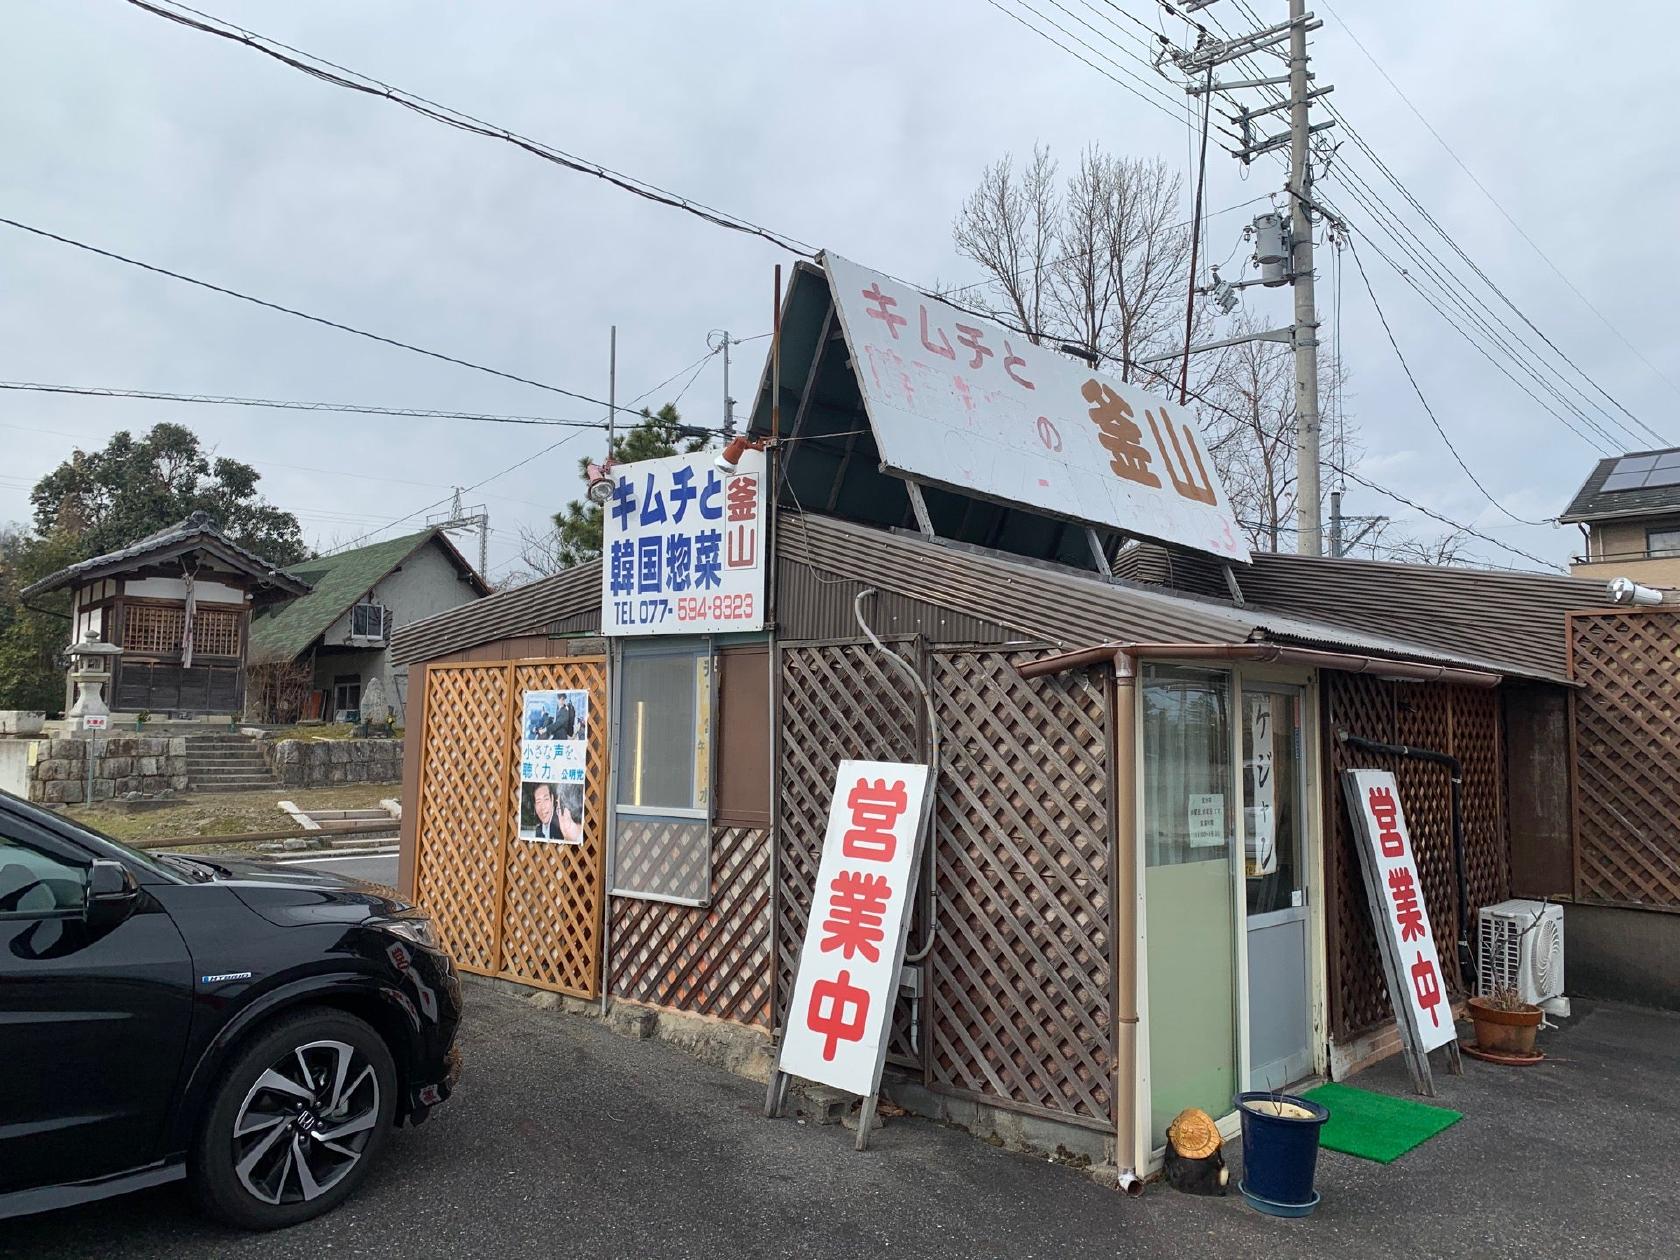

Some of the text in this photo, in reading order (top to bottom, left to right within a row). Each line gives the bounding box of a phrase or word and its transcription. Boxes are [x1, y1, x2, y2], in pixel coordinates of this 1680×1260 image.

[861, 282, 1035, 390] キムチと
[1081, 378, 1217, 506] 釜山
[611, 465, 723, 532] キムチと
[727, 476, 758, 569] 釜山
[610, 528, 723, 597] 韓国惣菜
[614, 601, 636, 625] TEL
[806, 777, 908, 1062] 営業中
[1368, 786, 1441, 1028] 営業中
